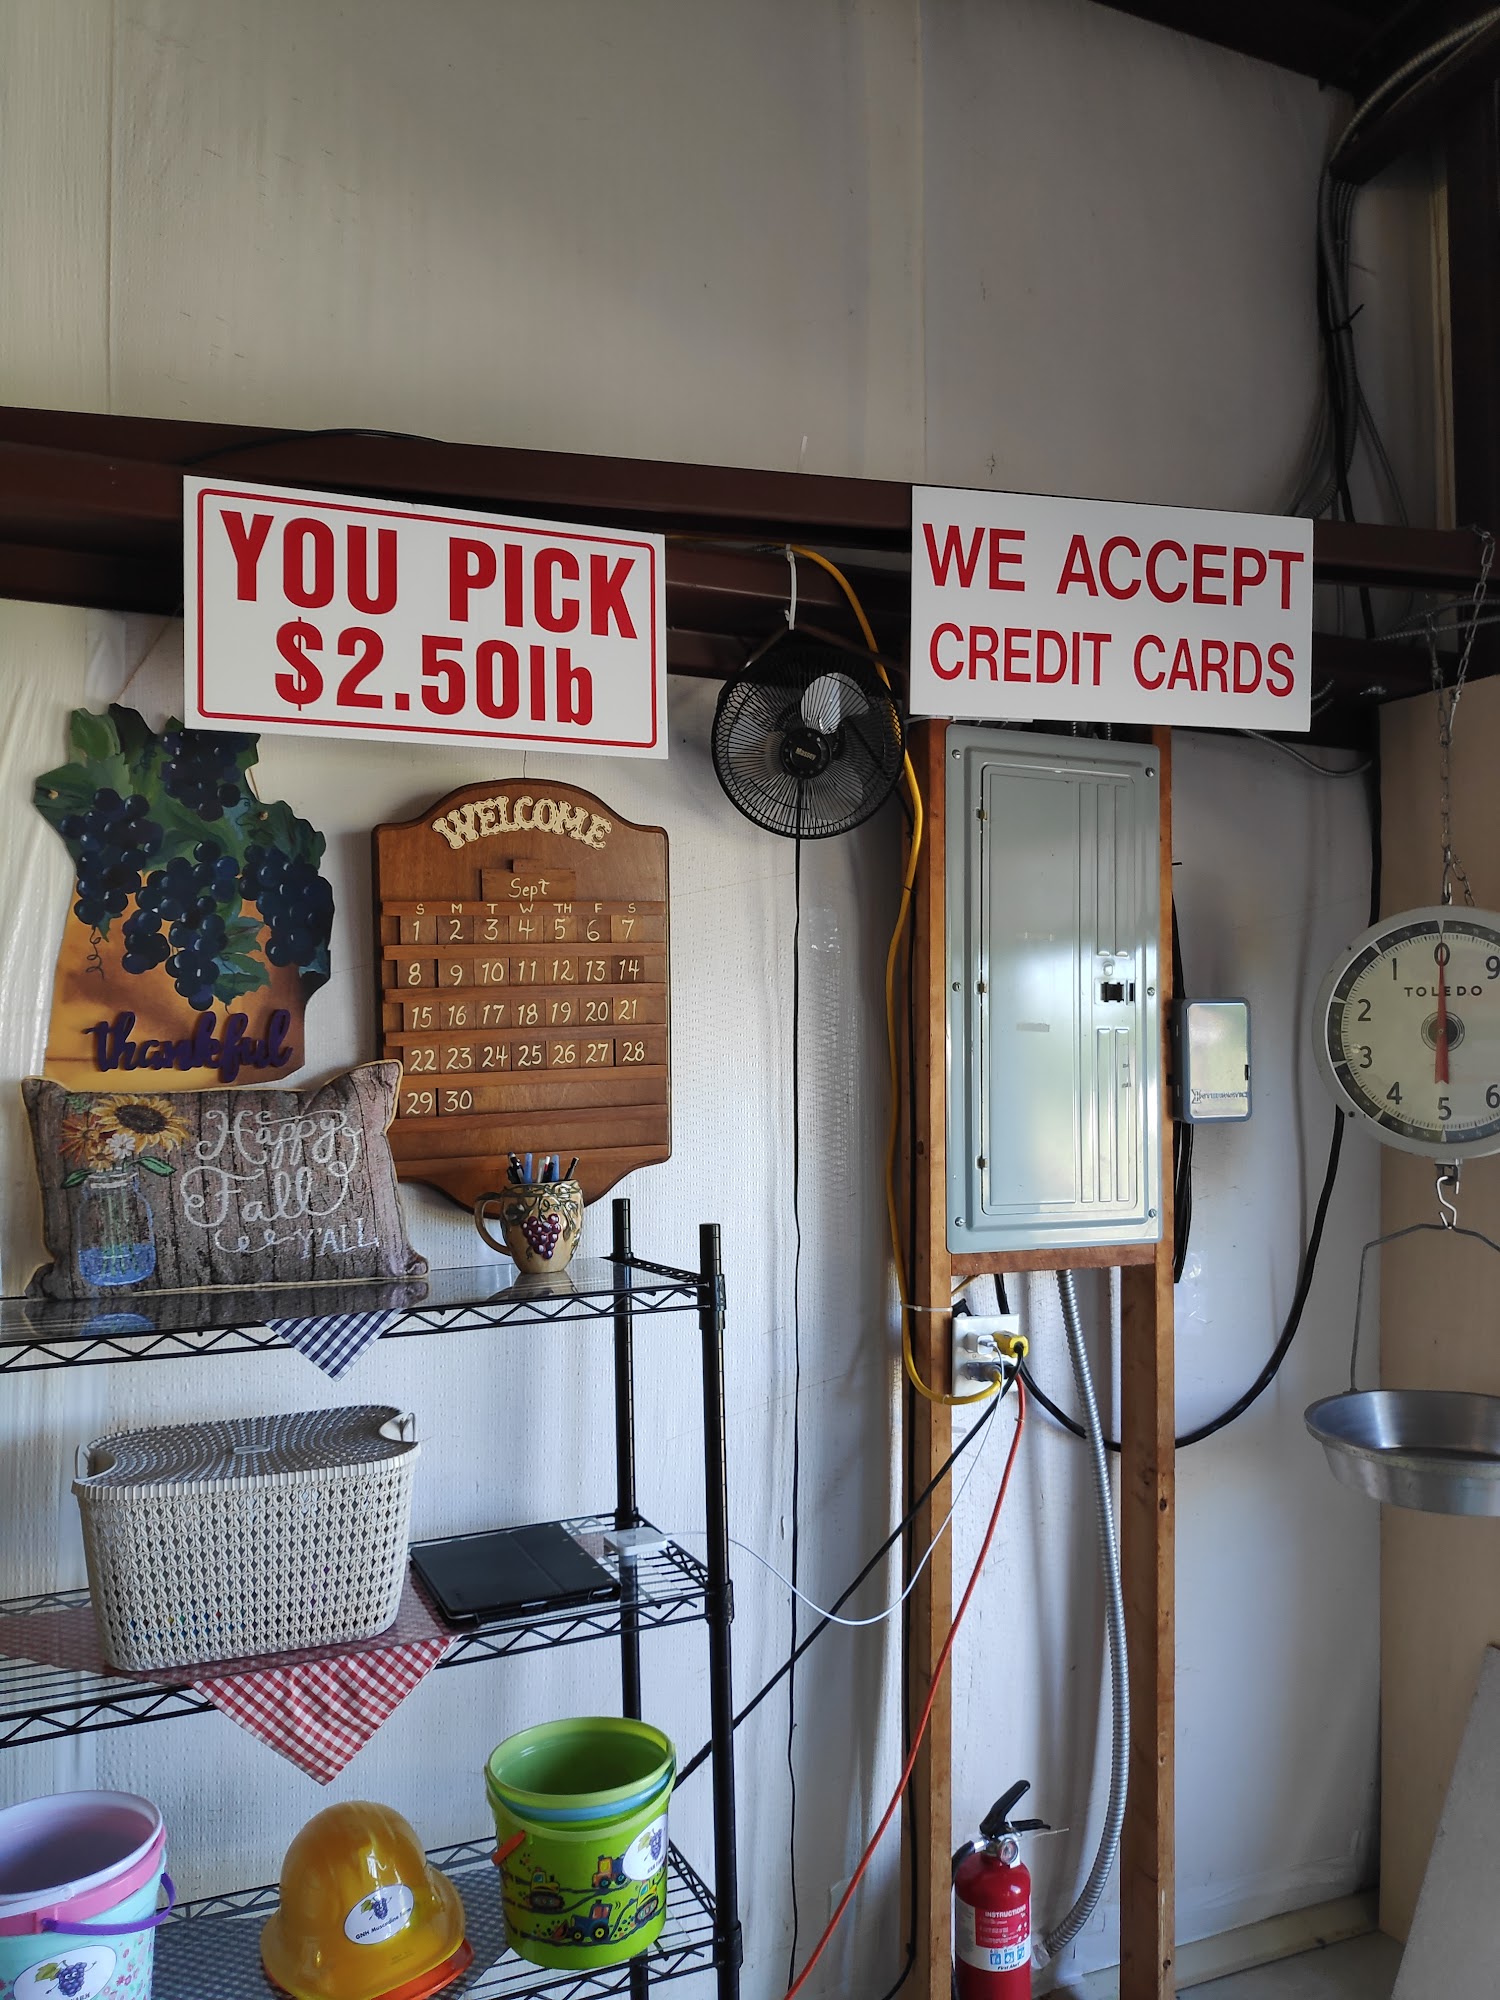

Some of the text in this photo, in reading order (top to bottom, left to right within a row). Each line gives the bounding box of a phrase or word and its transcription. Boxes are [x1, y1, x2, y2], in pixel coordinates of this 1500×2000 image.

[220, 510, 638, 639] YOU PICK
[922, 523, 1304, 609] WE ACCEPT
[274, 617, 593, 726] $2.50lb
[929, 622, 1295, 697] CREDIT CARDS
[432, 796, 612, 850] WELCOME
[508, 878, 549, 900] Sept
[416, 902, 636, 915] S M T W TH F S
[412, 919, 634, 941] 1 2 3 4 5 6 7
[408, 960, 640, 985] 8 9 10 11 12 13 14
[1434, 943, 1450, 967] 0
[1486, 956, 1500, 979] 9
[1404, 986, 1482, 997] TOLEDO
[412, 1000, 637, 1028] 15 16 17 18 19 20 21
[1358, 999, 1371, 1022] 2
[83, 1009, 293, 1083] thankful
[410, 1041, 645, 1071] 22 23 24 25 26 27 28
[1360, 1046, 1373, 1068] 3
[406, 1091, 472, 1114] 29 30
[1386, 1082, 1402, 1105] 4
[1439, 1097, 1451, 1120] 5
[1486, 1084, 1500, 1108] 6
[195, 1109, 363, 1169] Happy
[180, 1164, 351, 1228] Fall
[291, 1217, 380, 1259] Y'ALL
[355, 1930, 370, 1939] GNH
